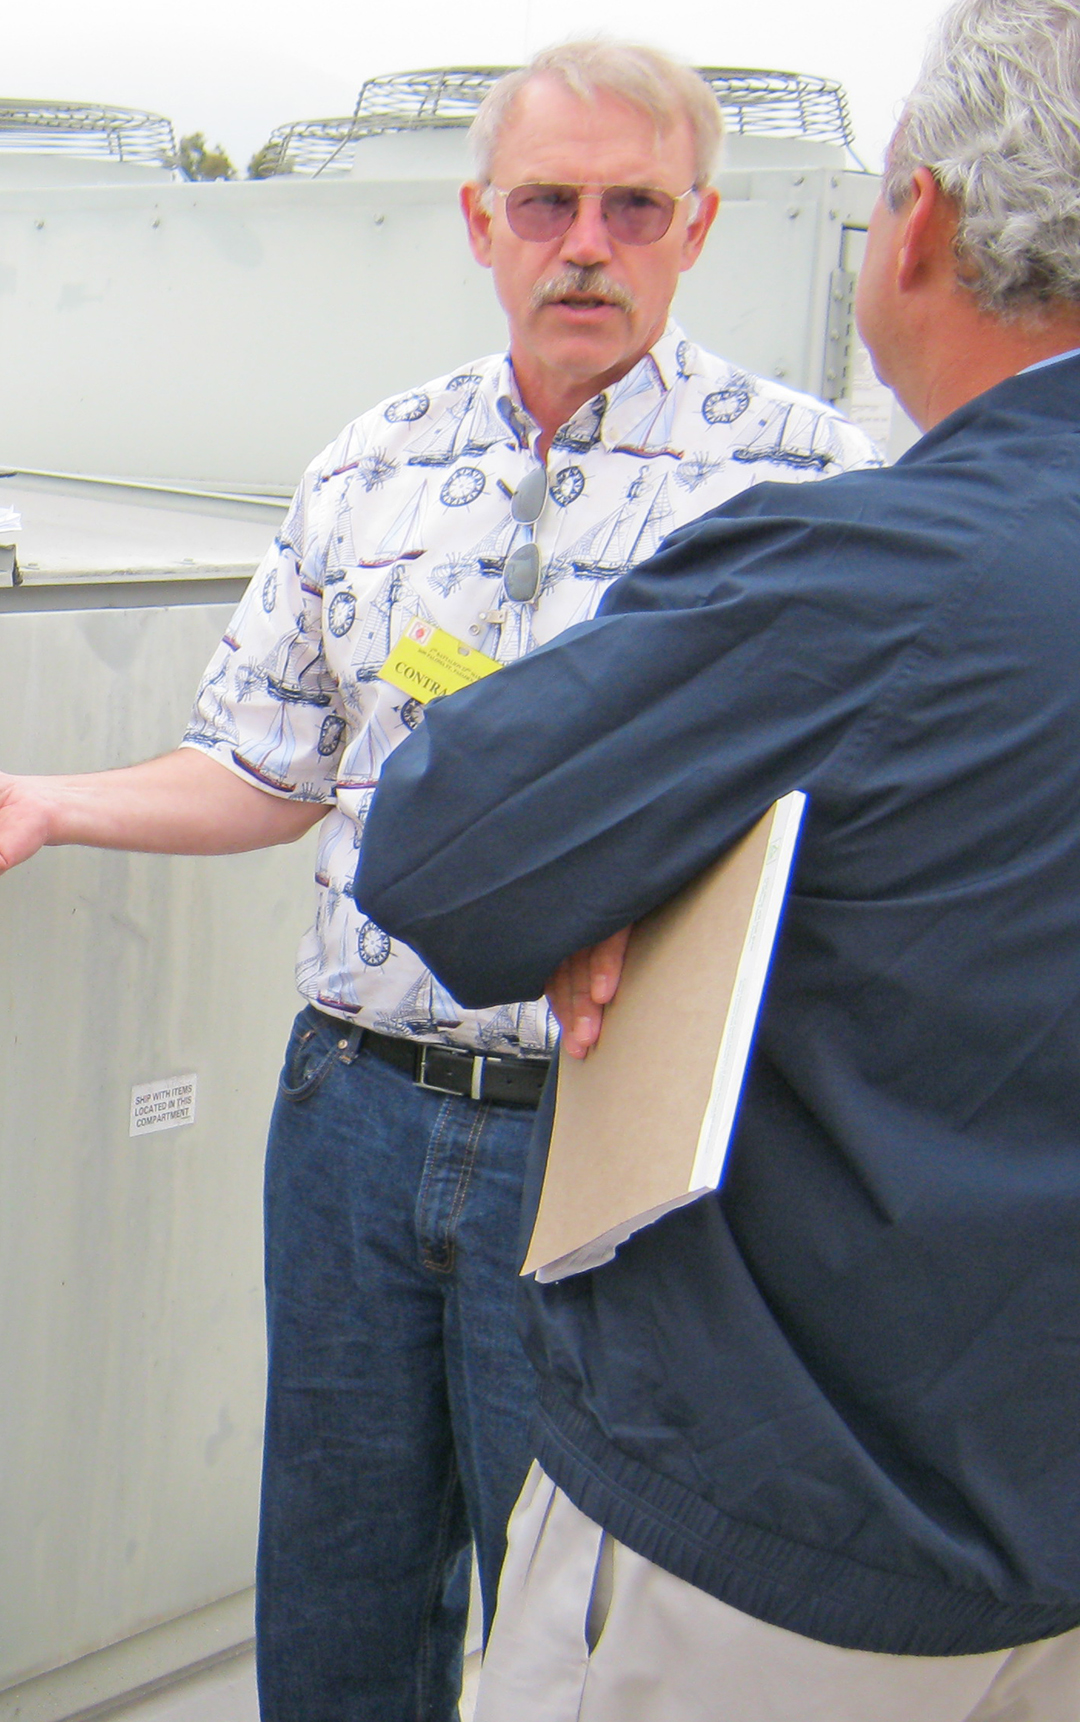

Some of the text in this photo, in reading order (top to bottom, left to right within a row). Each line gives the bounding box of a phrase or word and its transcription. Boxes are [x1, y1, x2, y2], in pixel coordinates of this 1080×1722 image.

[395, 662, 447, 695] CONTRA
[135, 1085, 192, 1105] SHIP WITH ITEMS
[135, 1096, 192, 1116] LOCATED IN THIS
[136, 1108, 188, 1127] COMPARTMENT
